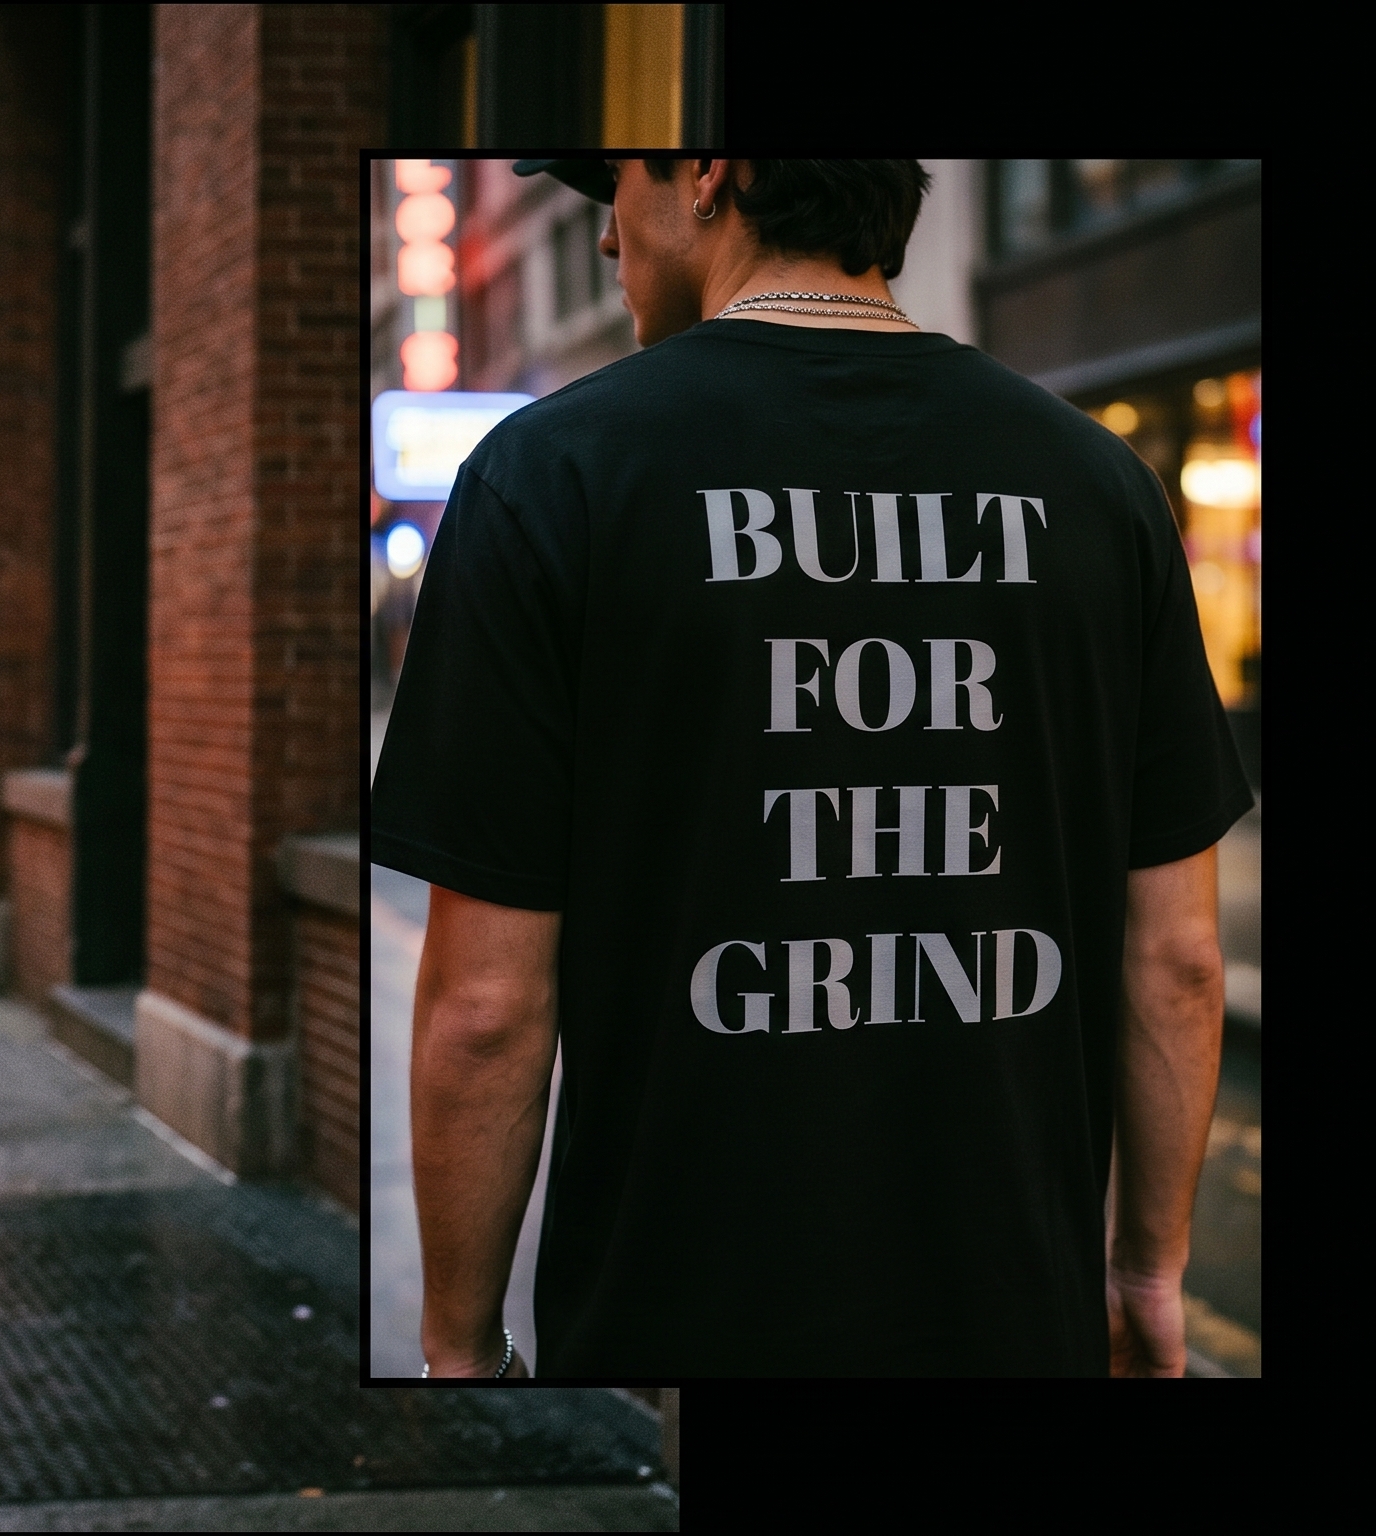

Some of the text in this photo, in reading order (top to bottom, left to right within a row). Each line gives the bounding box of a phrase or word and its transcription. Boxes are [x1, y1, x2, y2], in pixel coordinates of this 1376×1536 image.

[696, 488, 1047, 583] BUILT
[764, 638, 1003, 732] FOR
[764, 785, 1001, 881] THE
[691, 929, 1062, 1033] GRIND
